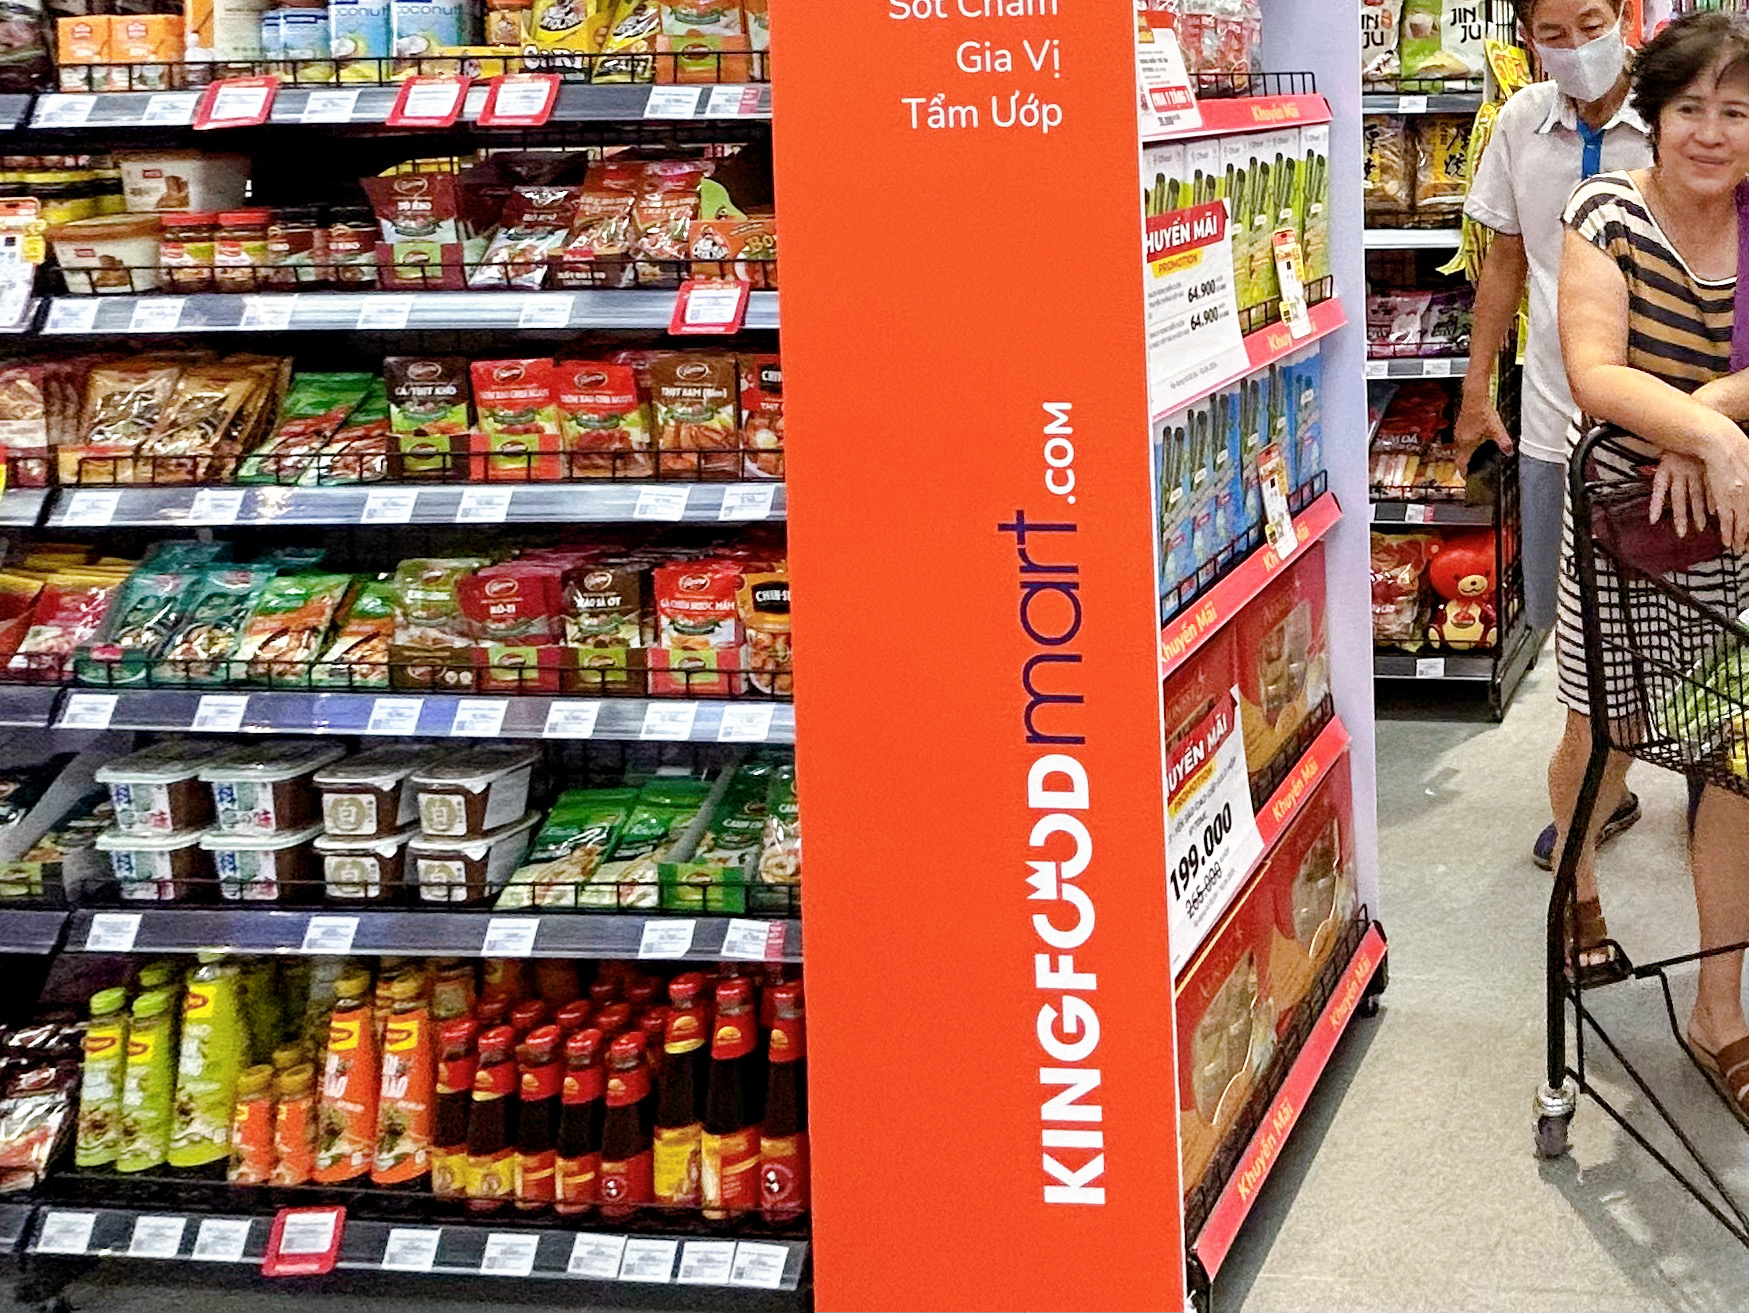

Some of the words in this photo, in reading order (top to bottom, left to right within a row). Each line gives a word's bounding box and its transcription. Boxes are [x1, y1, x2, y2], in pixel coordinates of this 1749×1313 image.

[1361, 13, 1379, 30] IN
[1451, 7, 1476, 26] JIN
[1460, 22, 1482, 43] JU
[956, 40, 1013, 74] Gia
[1023, 38, 1062, 78] Vị
[1363, 30, 1384, 49] JU
[901, 94, 979, 130] Tẩm
[991, 90, 1063, 134] Ướp
[1146, 217, 1191, 254] HUYẾN
[1194, 211, 1218, 241] MÃI
[1188, 279, 1216, 303] 64.900
[1191, 306, 1219, 331] 64.900
[1196, 601, 1218, 634] Mãi
[1166, 738, 1206, 799] UYẾN
[1207, 713, 1228, 756] MÃI
[1272, 777, 1304, 823] Khuyến
[1299, 755, 1319, 789] Mãi
[1170, 801, 1233, 902] 199.000
[1330, 977, 1358, 1030] Khuyến
[1353, 955, 1372, 991] Mãi
[1237, 1134, 1276, 1203] Khuyến
[1272, 1097, 1295, 1143] Mãi
